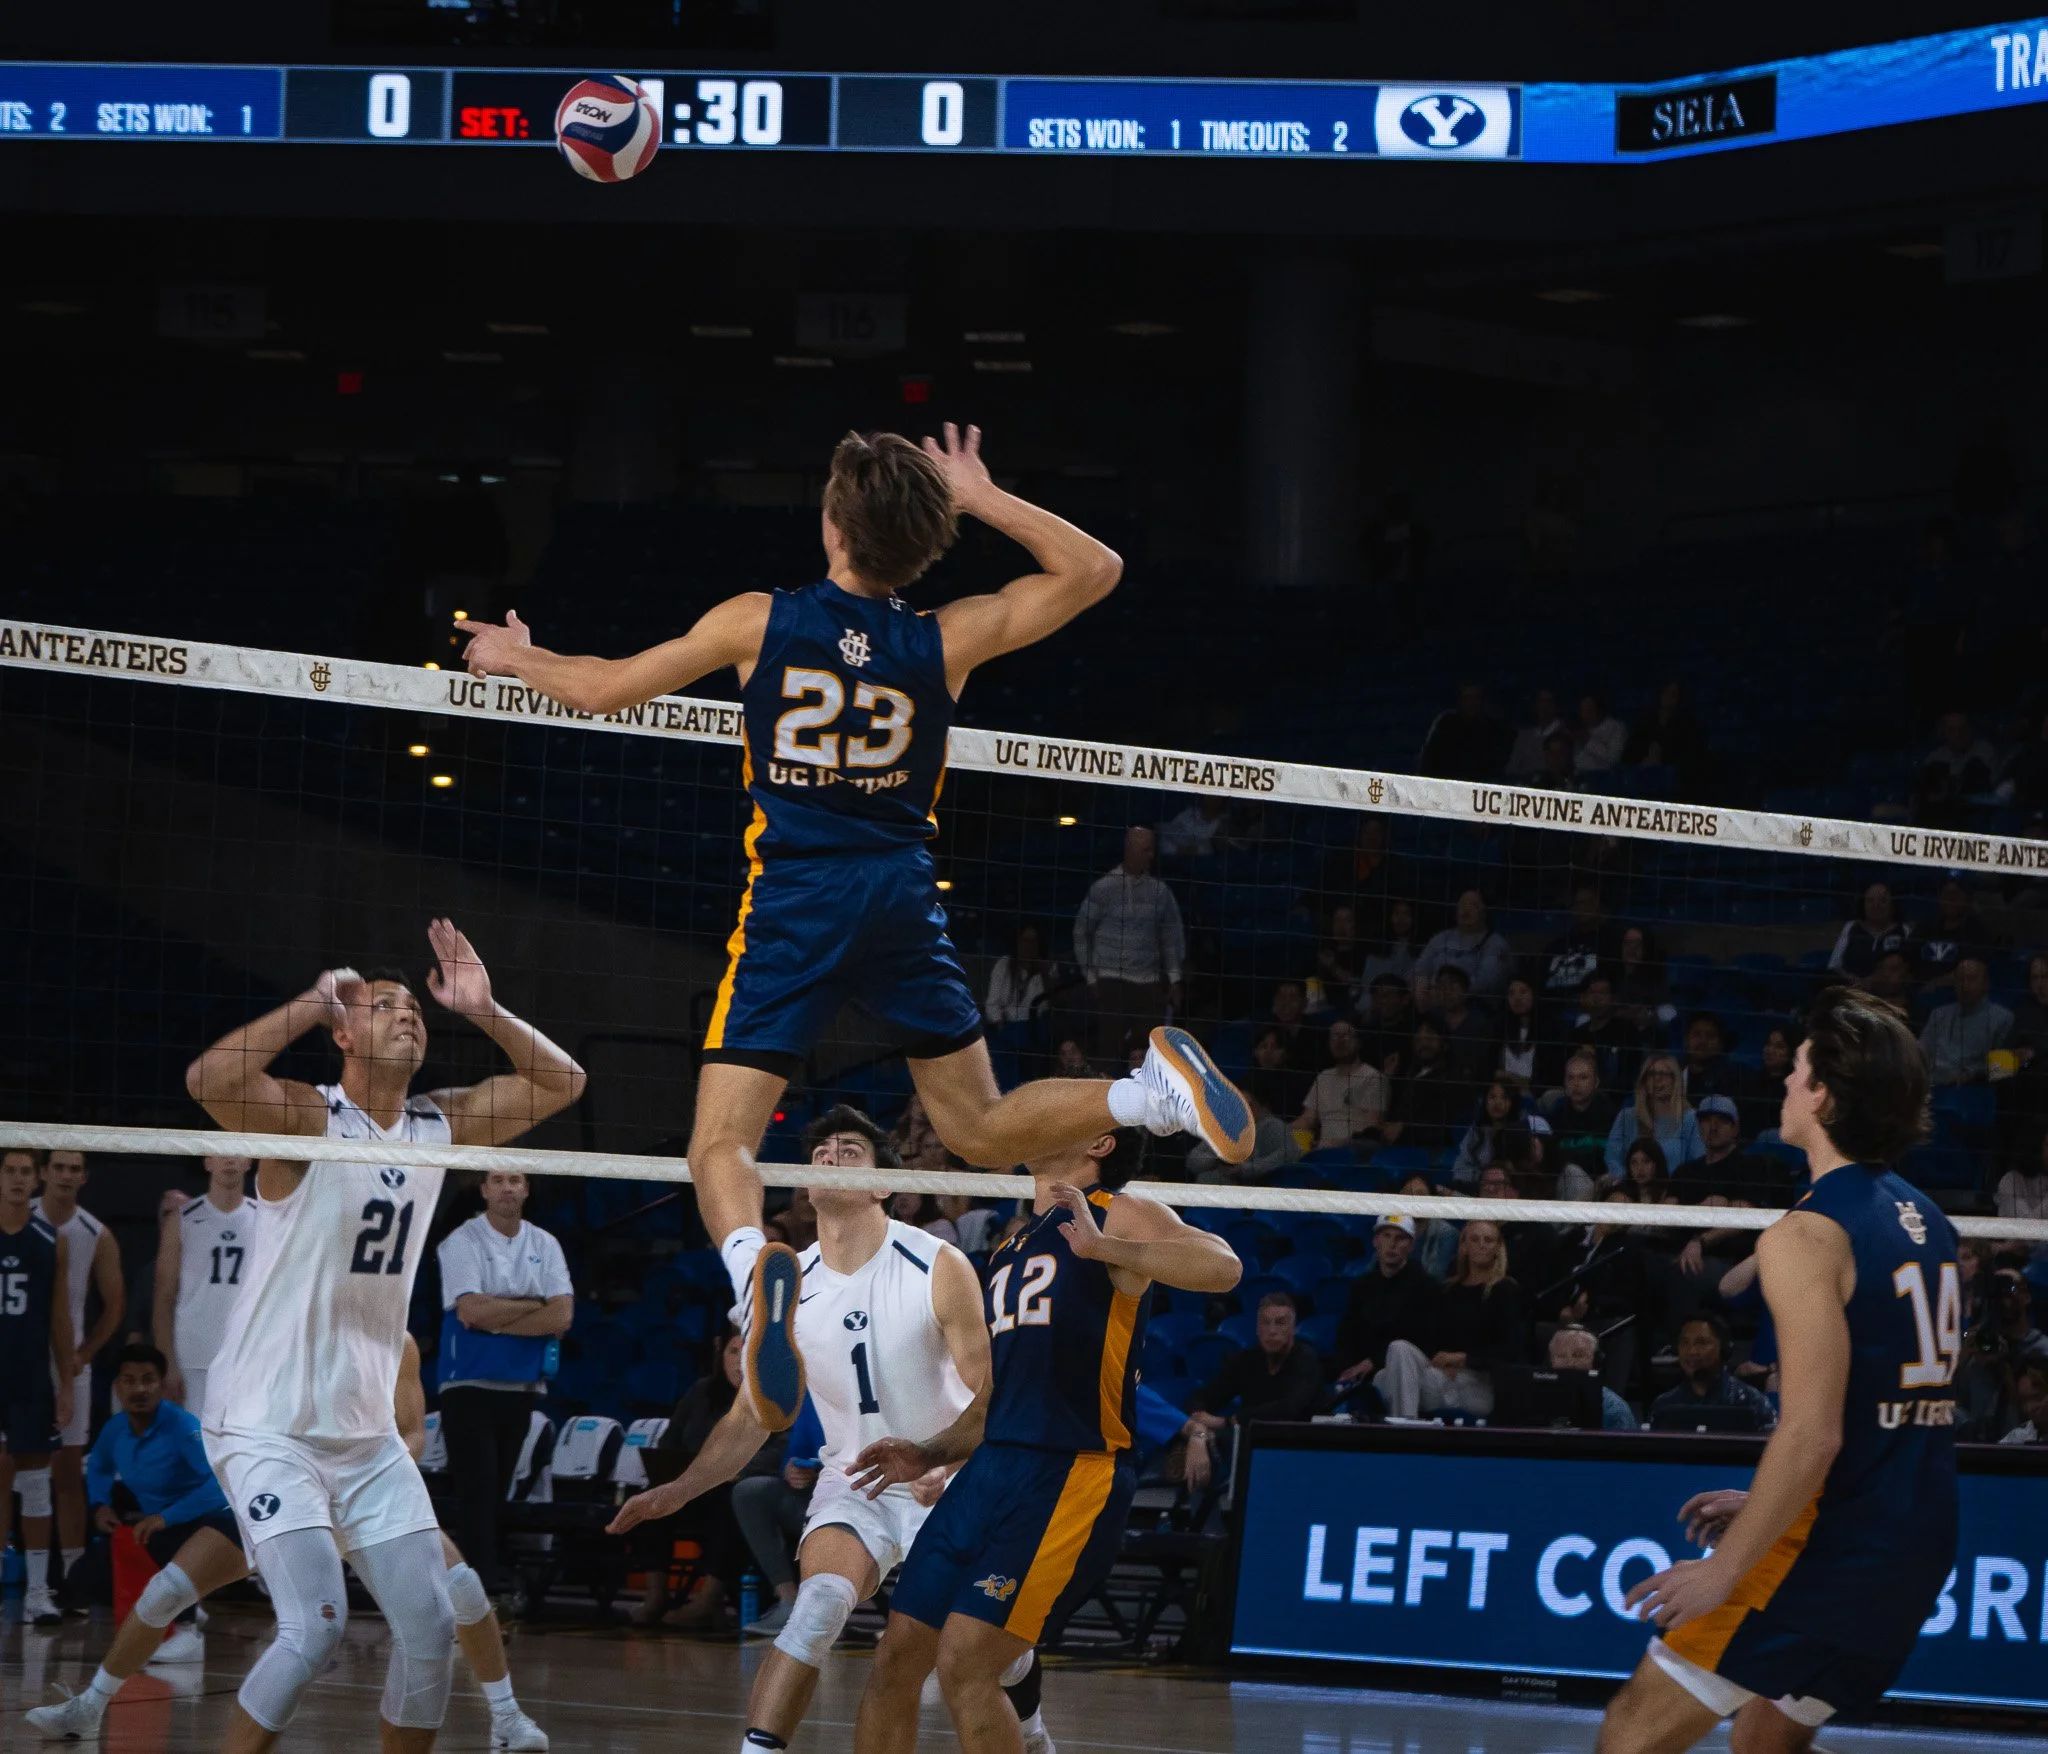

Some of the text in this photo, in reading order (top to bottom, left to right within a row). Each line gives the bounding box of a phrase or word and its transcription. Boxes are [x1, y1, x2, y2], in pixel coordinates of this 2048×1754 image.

[51, 102, 65, 131] 2
[98, 103, 251, 134] SETS WON: 1
[368, 73, 411, 138] 0
[460, 107, 529, 138] SET:
[921, 82, 963, 146] 0
[1652, 93, 1745, 140] SEIA
[1029, 118, 1180, 149] SETS WON: 1
[1201, 120, 1348, 151] TIMEOUTS: 2
[0, 627, 188, 676] ANTEATERS
[449, 679, 486, 709] UC
[604, 701, 744, 737] NTEATE
[773, 666, 915, 768] 23
[768, 762, 808, 786] UC
[996, 738, 1276, 792] UC IRVINE ANTEATERS
[1472, 789, 1718, 837] UC IRVINE ANTEATERS
[1890, 832, 1917, 856] UC
[1922, 835, 1990, 863] IRVINE
[351, 1198, 414, 1274] 21
[209, 1246, 244, 1284] 17
[989, 1254, 1057, 1339] 12
[1892, 1262, 1962, 1389] 14
[851, 1342, 880, 1415] 1
[1304, 1524, 1680, 1622] LEFT CO
